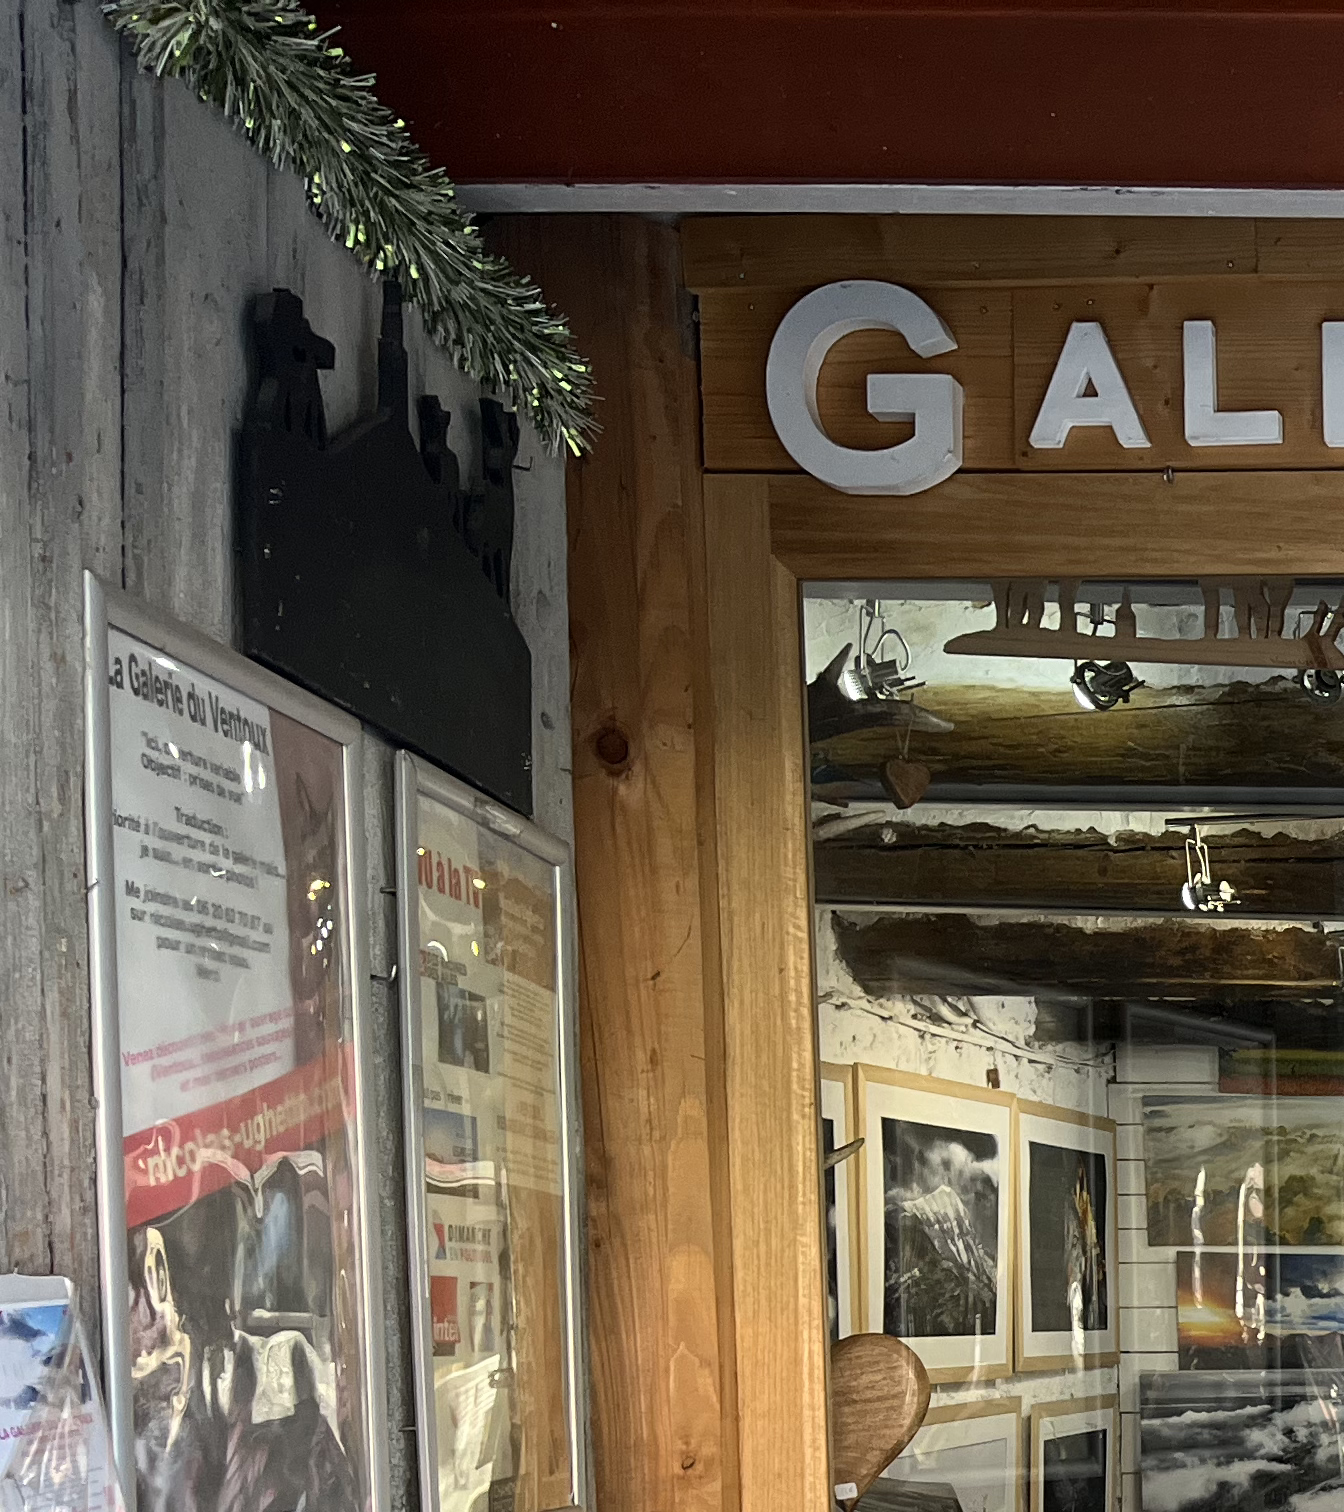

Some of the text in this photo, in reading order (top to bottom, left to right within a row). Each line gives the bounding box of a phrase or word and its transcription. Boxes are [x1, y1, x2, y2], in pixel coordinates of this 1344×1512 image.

[128, 652, 184, 717] Galerie
[187, 682, 207, 727] du
[208, 690, 270, 757] Ventoux
[448, 1224, 491, 1246] DIMANCHE
